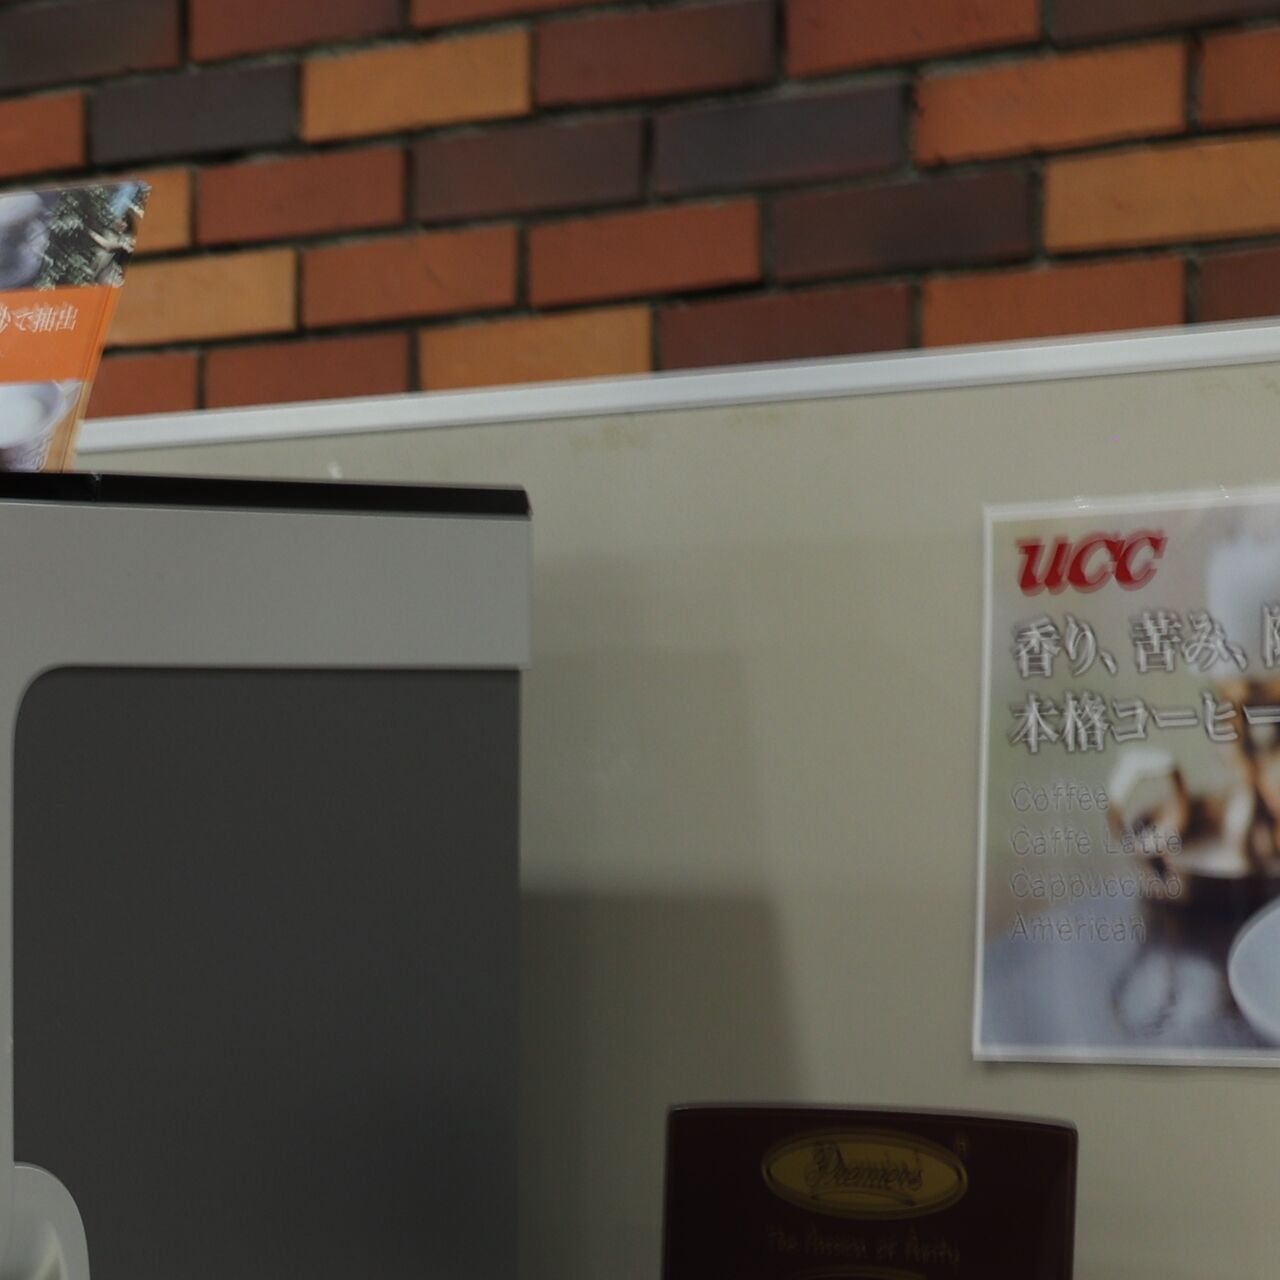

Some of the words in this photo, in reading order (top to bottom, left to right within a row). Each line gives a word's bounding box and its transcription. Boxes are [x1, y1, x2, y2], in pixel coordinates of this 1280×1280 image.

[1010, 687, 1280, 754] 本格コーヒー
[1010, 782, 1110, 813] Coffee
[1010, 826, 1092, 857] Caffe
[1104, 824, 1183, 856] Latte
[1010, 870, 1183, 902] Cappuccino
[1009, 915, 1146, 944] American
